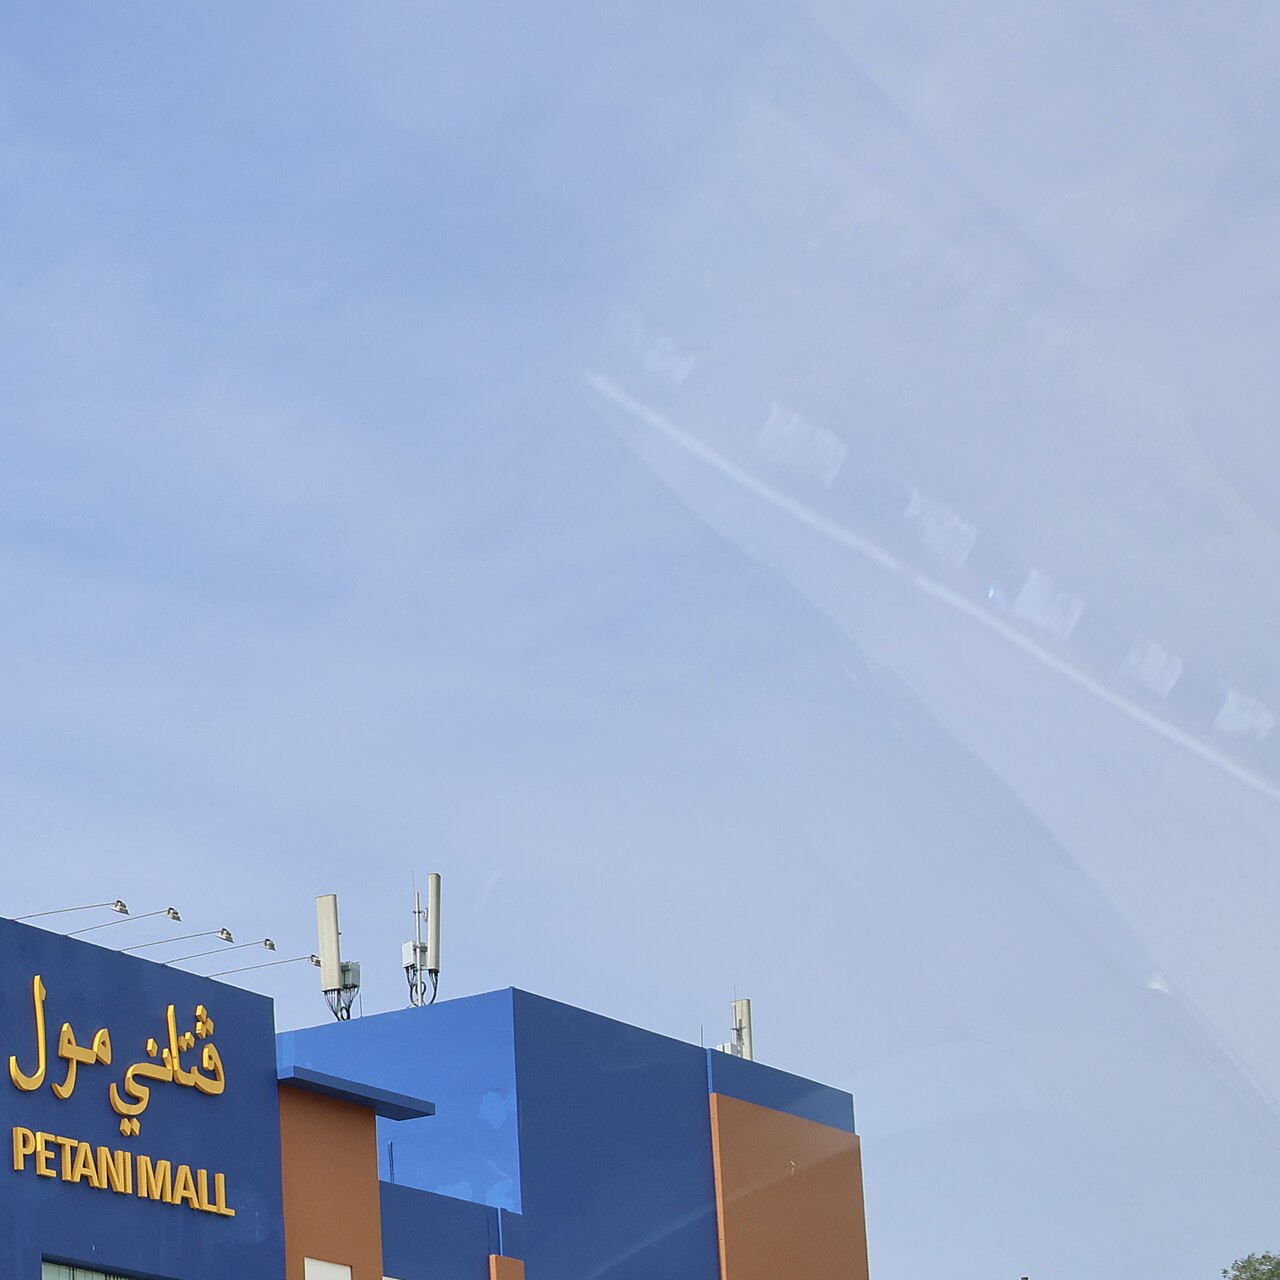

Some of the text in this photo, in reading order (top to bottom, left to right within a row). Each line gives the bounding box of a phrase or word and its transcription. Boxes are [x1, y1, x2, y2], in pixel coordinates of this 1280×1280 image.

[9, 974, 112, 1099] مول
[12, 1127, 236, 1217] PETANI MALL
